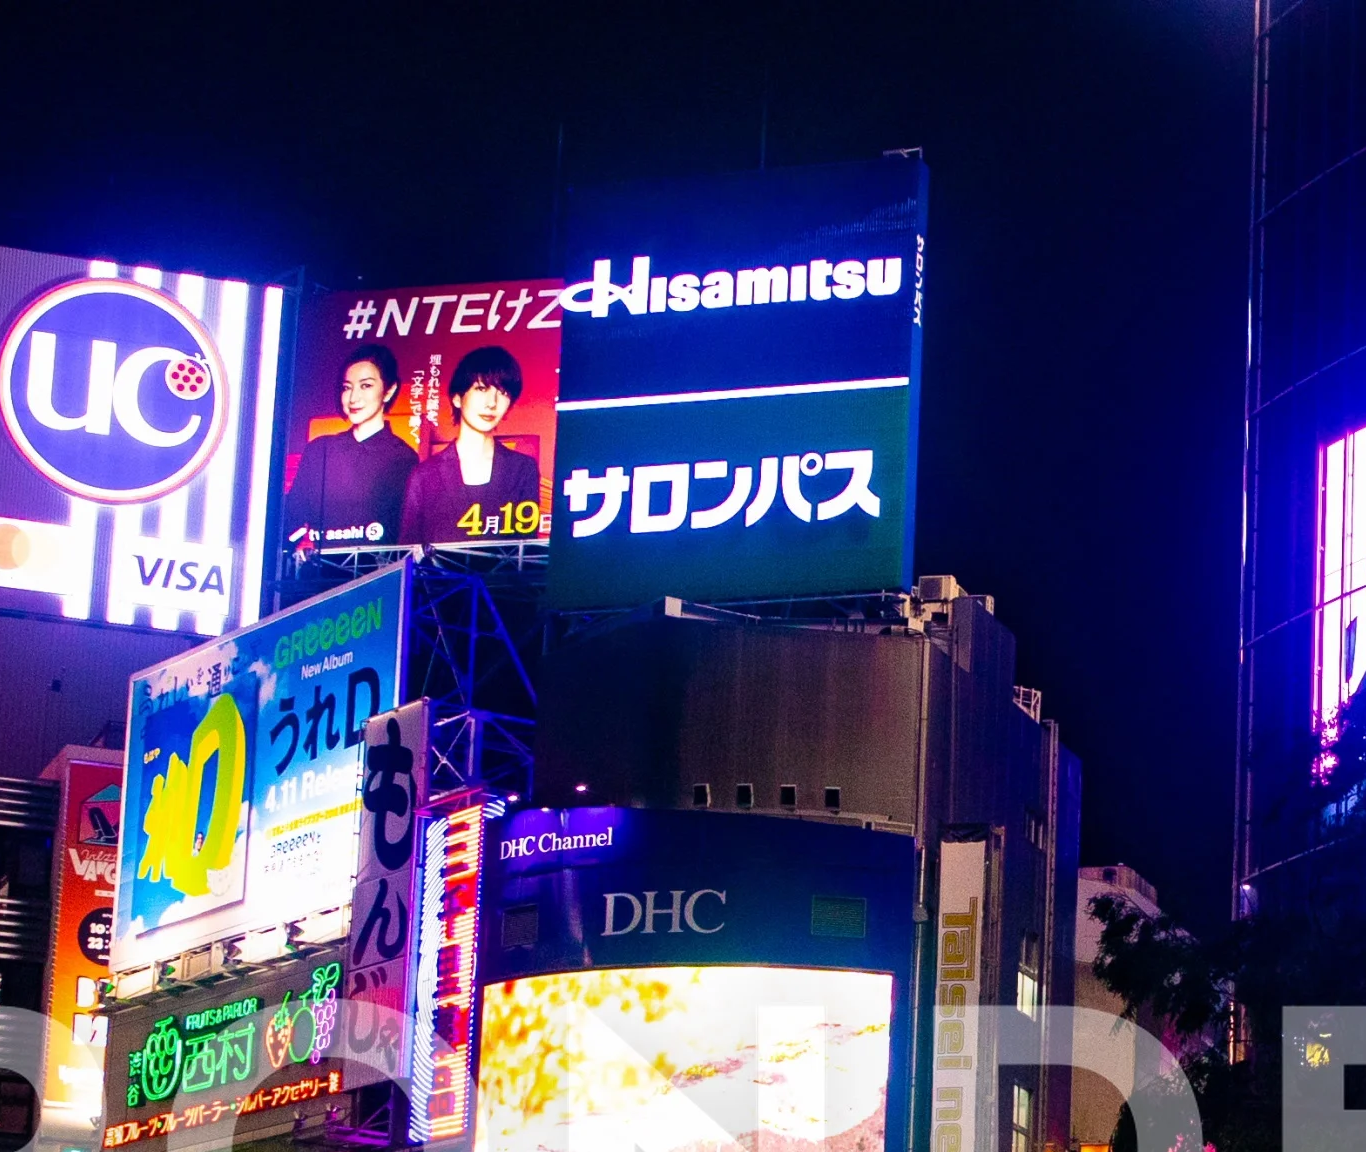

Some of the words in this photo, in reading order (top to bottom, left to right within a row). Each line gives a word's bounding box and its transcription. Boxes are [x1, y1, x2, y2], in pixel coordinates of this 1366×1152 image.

[559, 256, 902, 318] Hisamitsu
[457, 501, 552, 537] 4月19日
[564, 449, 881, 538] サロンパス
[326, 525, 364, 540] asahi
[134, 555, 226, 596] VISA
[301, 663, 324, 681] New
[322, 650, 354, 674] Album
[269, 667, 381, 776] うれD
[500, 836, 536, 861] DHC
[537, 826, 614, 854] Channel
[600, 888, 728, 937] DHC
[937, 897, 979, 1070] Taisei
[126, 1051, 143, 1108] 渋谷
[182, 1022, 256, 1093] 西村
